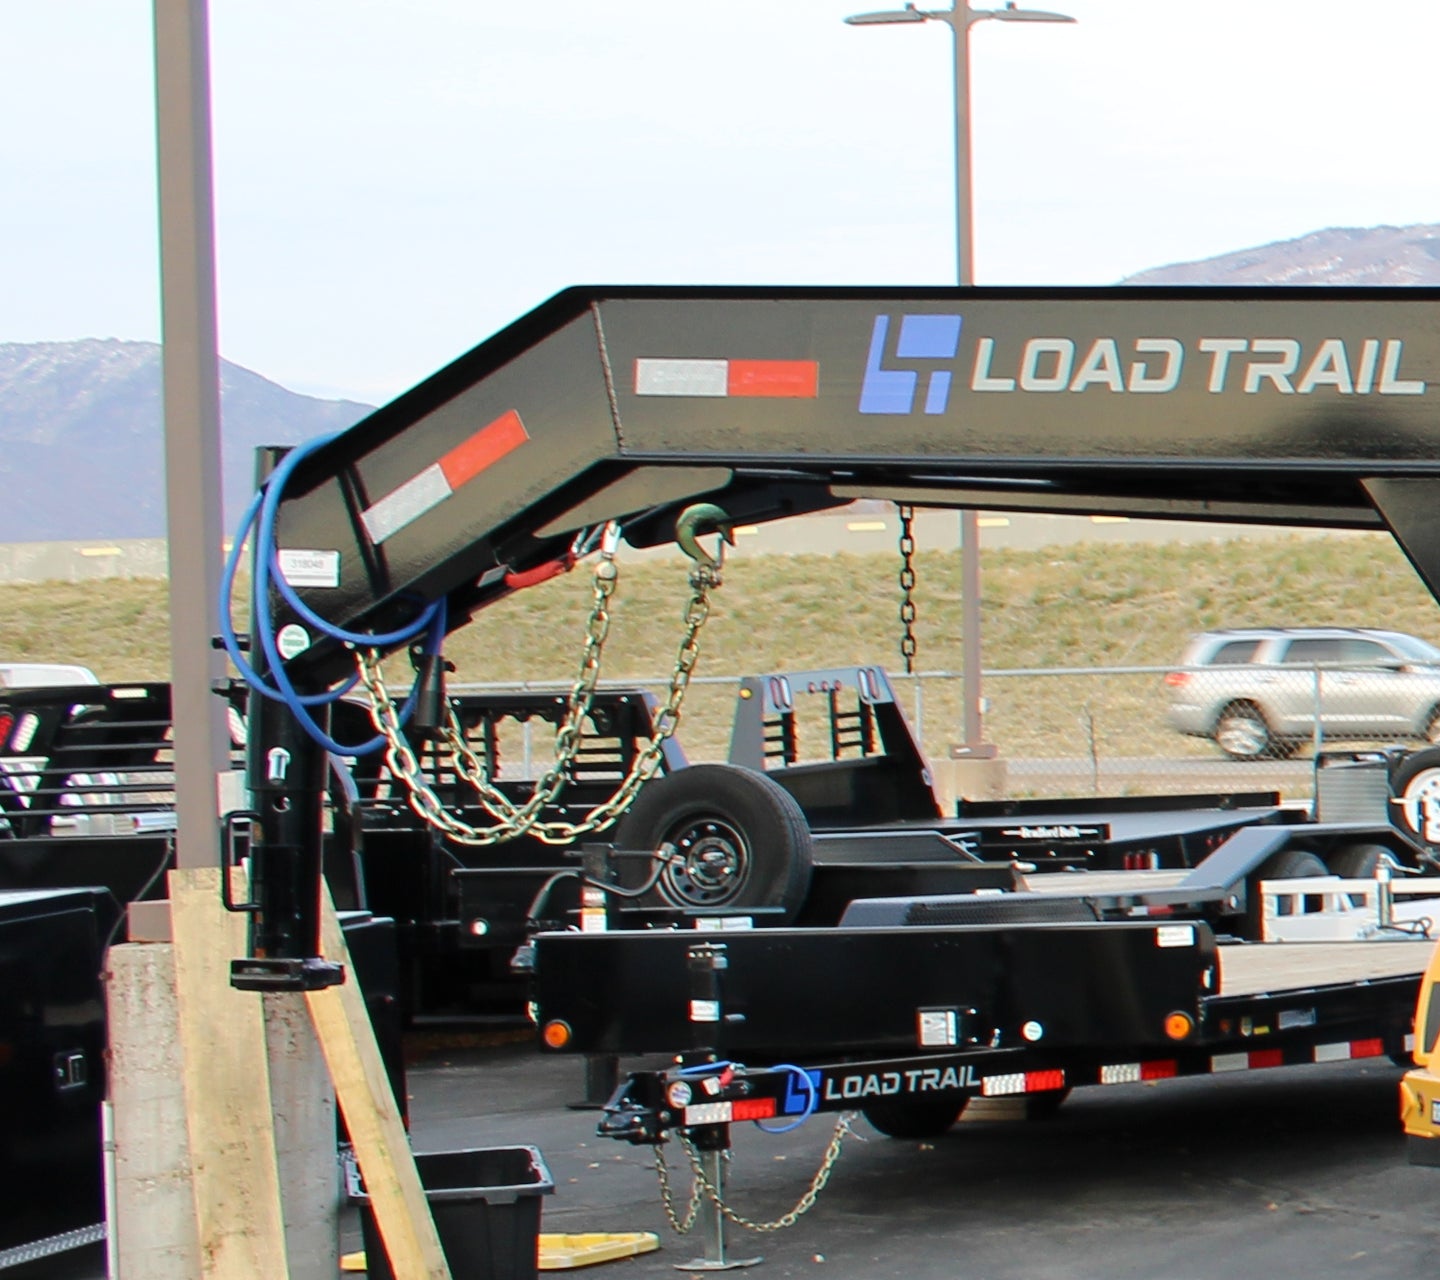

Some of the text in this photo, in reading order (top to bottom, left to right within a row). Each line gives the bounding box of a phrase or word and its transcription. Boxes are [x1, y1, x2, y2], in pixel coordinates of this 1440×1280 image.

[970, 337, 1426, 395] LOAD TRAIL
[825, 1066, 982, 1100] LOAD TRAIL
